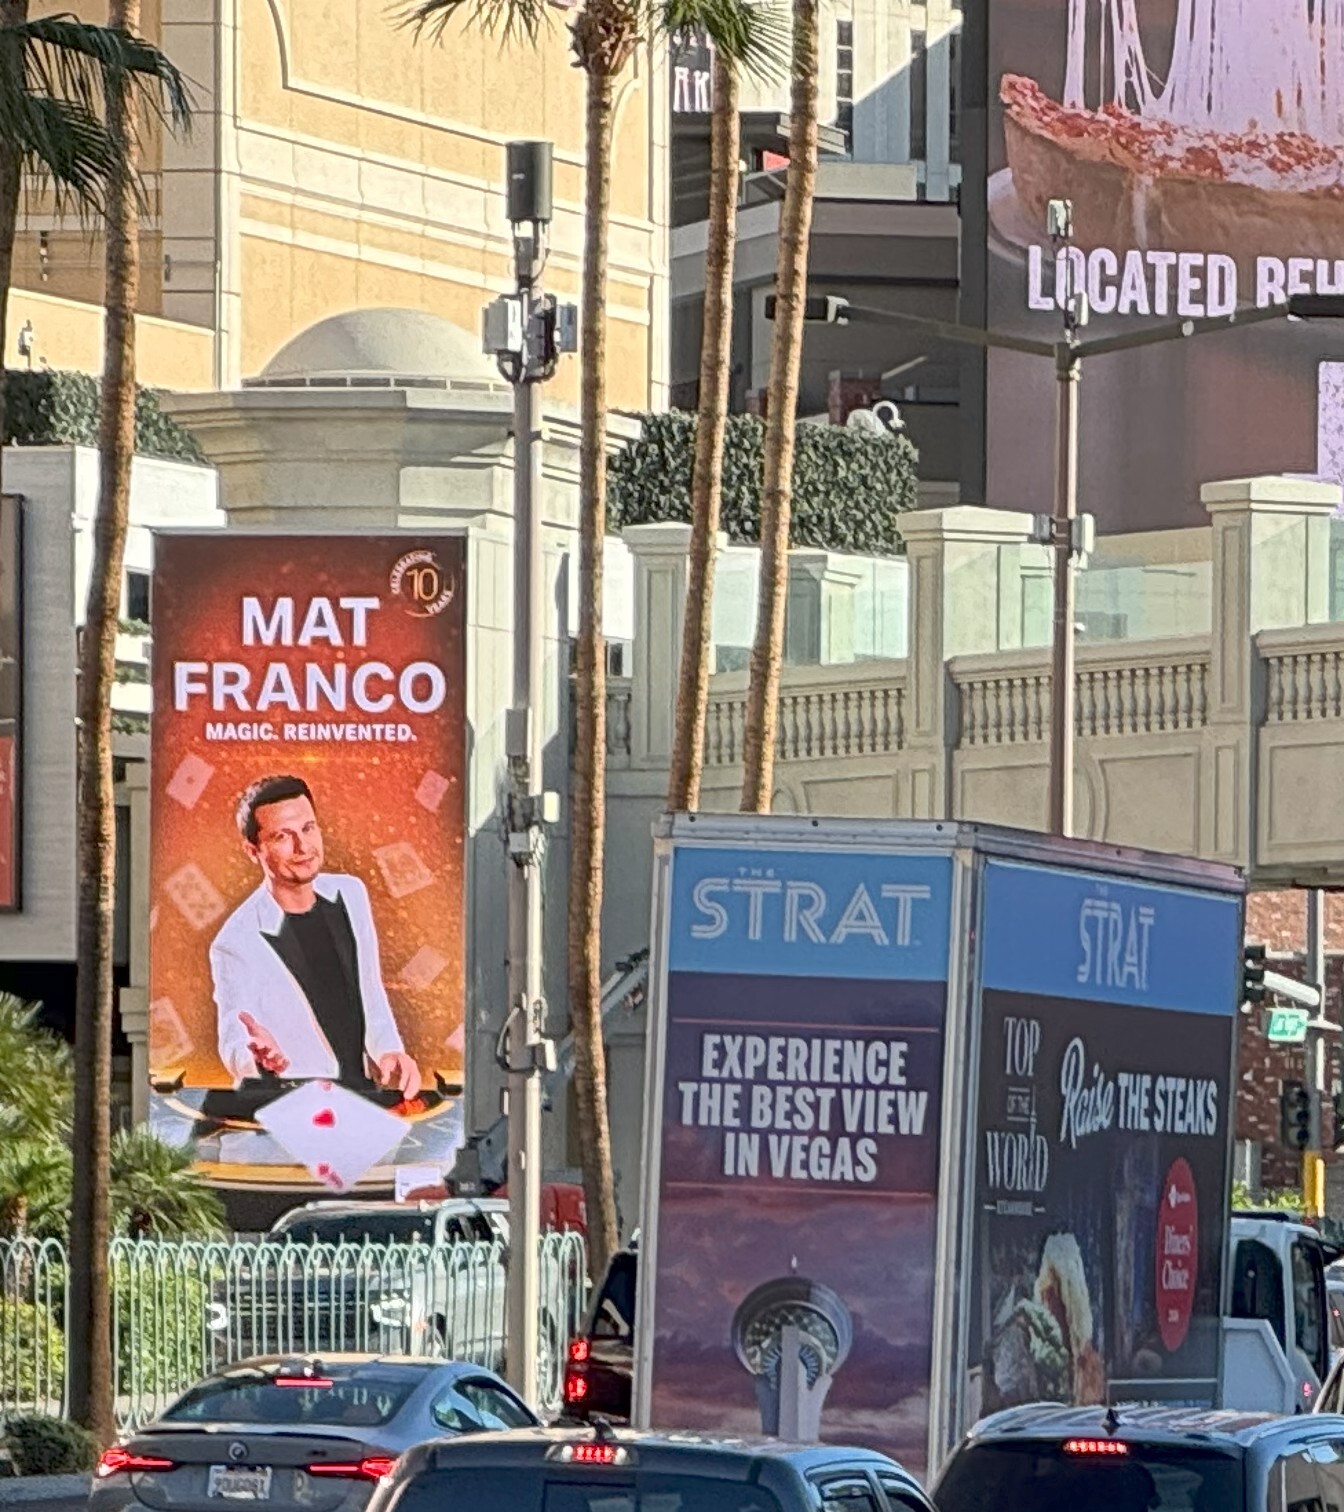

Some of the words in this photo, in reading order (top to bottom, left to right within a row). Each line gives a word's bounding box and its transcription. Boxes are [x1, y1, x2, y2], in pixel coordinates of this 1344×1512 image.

[1027, 245, 1237, 318] LOCATED
[406, 568, 439, 600] 10
[242, 596, 380, 647] MAT
[173, 661, 446, 713] FRANCO
[206, 722, 279, 741] MAGIC.
[283, 723, 418, 742] REINVENTED.
[738, 866, 775, 877] THE
[690, 877, 932, 946] STRAT
[1076, 898, 1156, 991] STRAT
[702, 1033, 909, 1087] EXPERIENCE
[1003, 1015, 1041, 1077] TOP
[677, 1080, 742, 1128] THE
[750, 1083, 837, 1132] BEST
[841, 1087, 929, 1136] VIEW
[1059, 1036, 1115, 1150] Raise
[1117, 1072, 1151, 1131] THE
[1153, 1074, 1218, 1137] STEAKS
[723, 1131, 760, 1177] IN
[767, 1134, 879, 1183] VEGAS
[985, 1129, 1049, 1193] WORLD
